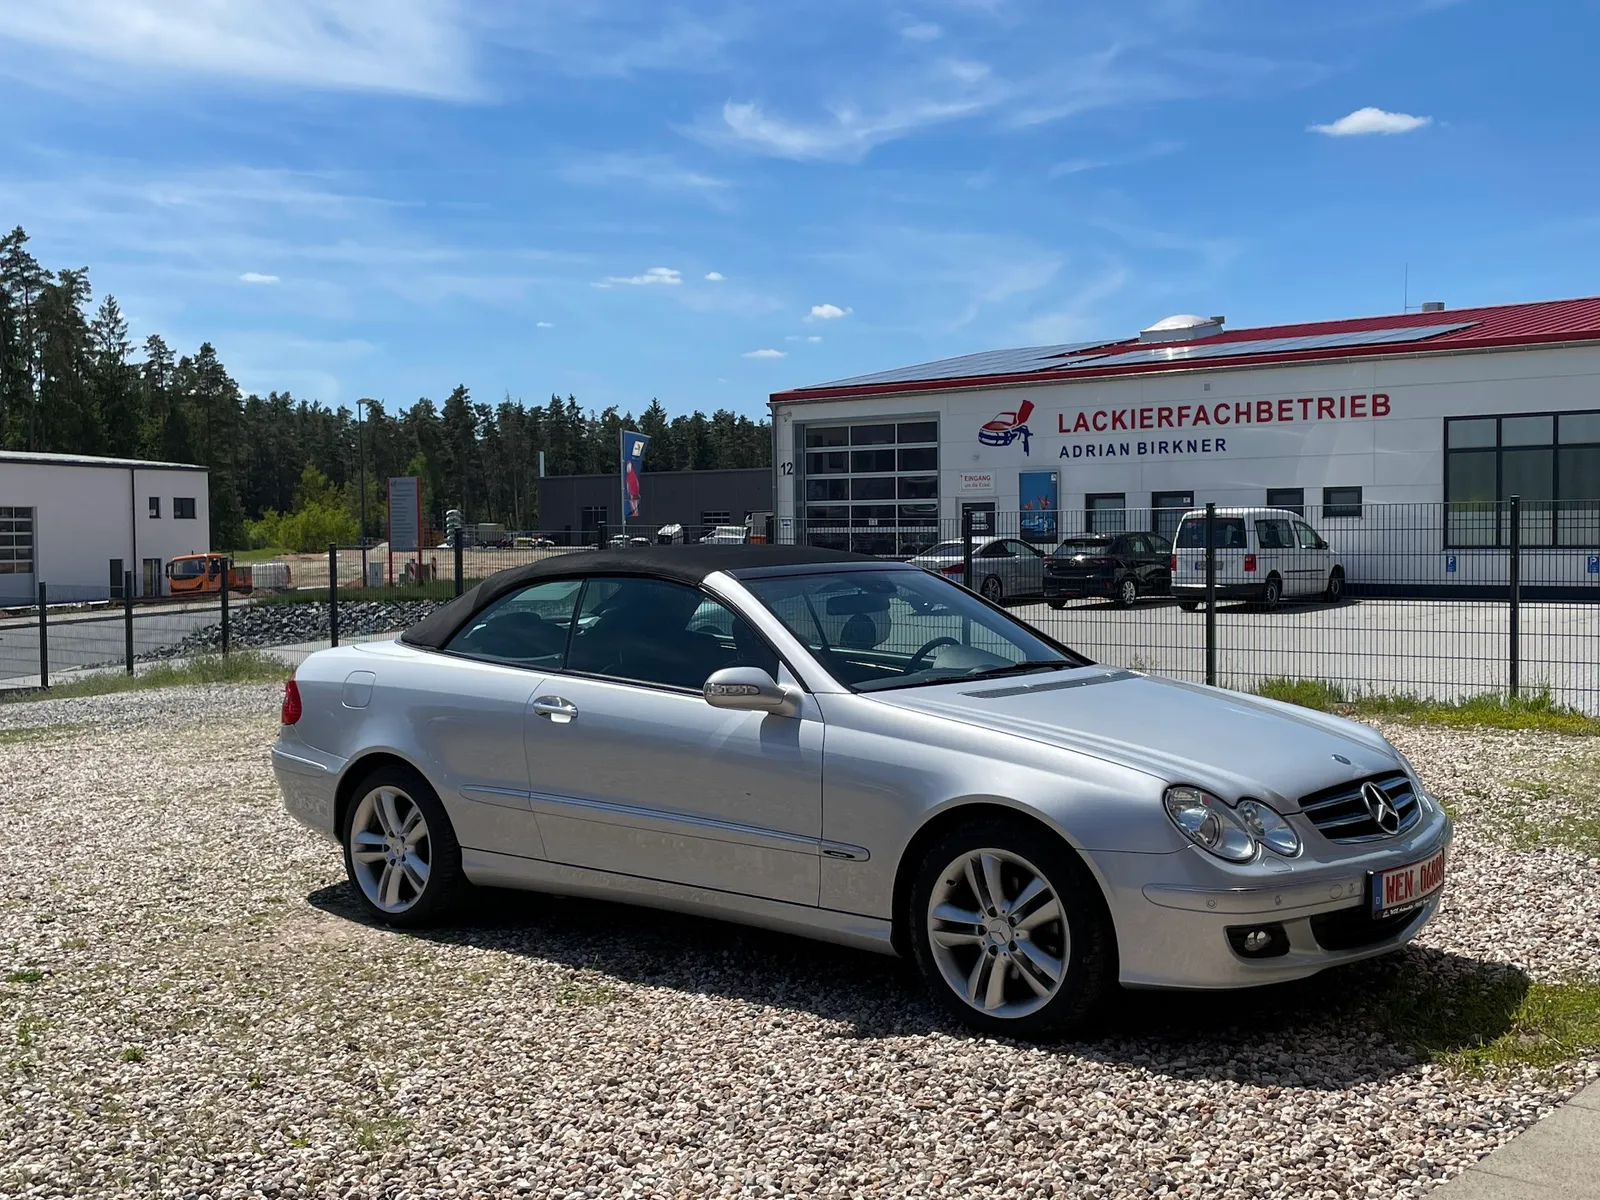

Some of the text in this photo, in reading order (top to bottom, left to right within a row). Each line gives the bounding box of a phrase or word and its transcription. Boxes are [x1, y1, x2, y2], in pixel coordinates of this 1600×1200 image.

[1058, 393, 1391, 433] LACKIERFACHBETRIEB
[1059, 438, 1227, 459] ADRIAN BIRKNER
[780, 461, 794, 476] 12
[1385, 870, 1414, 904] WEN
